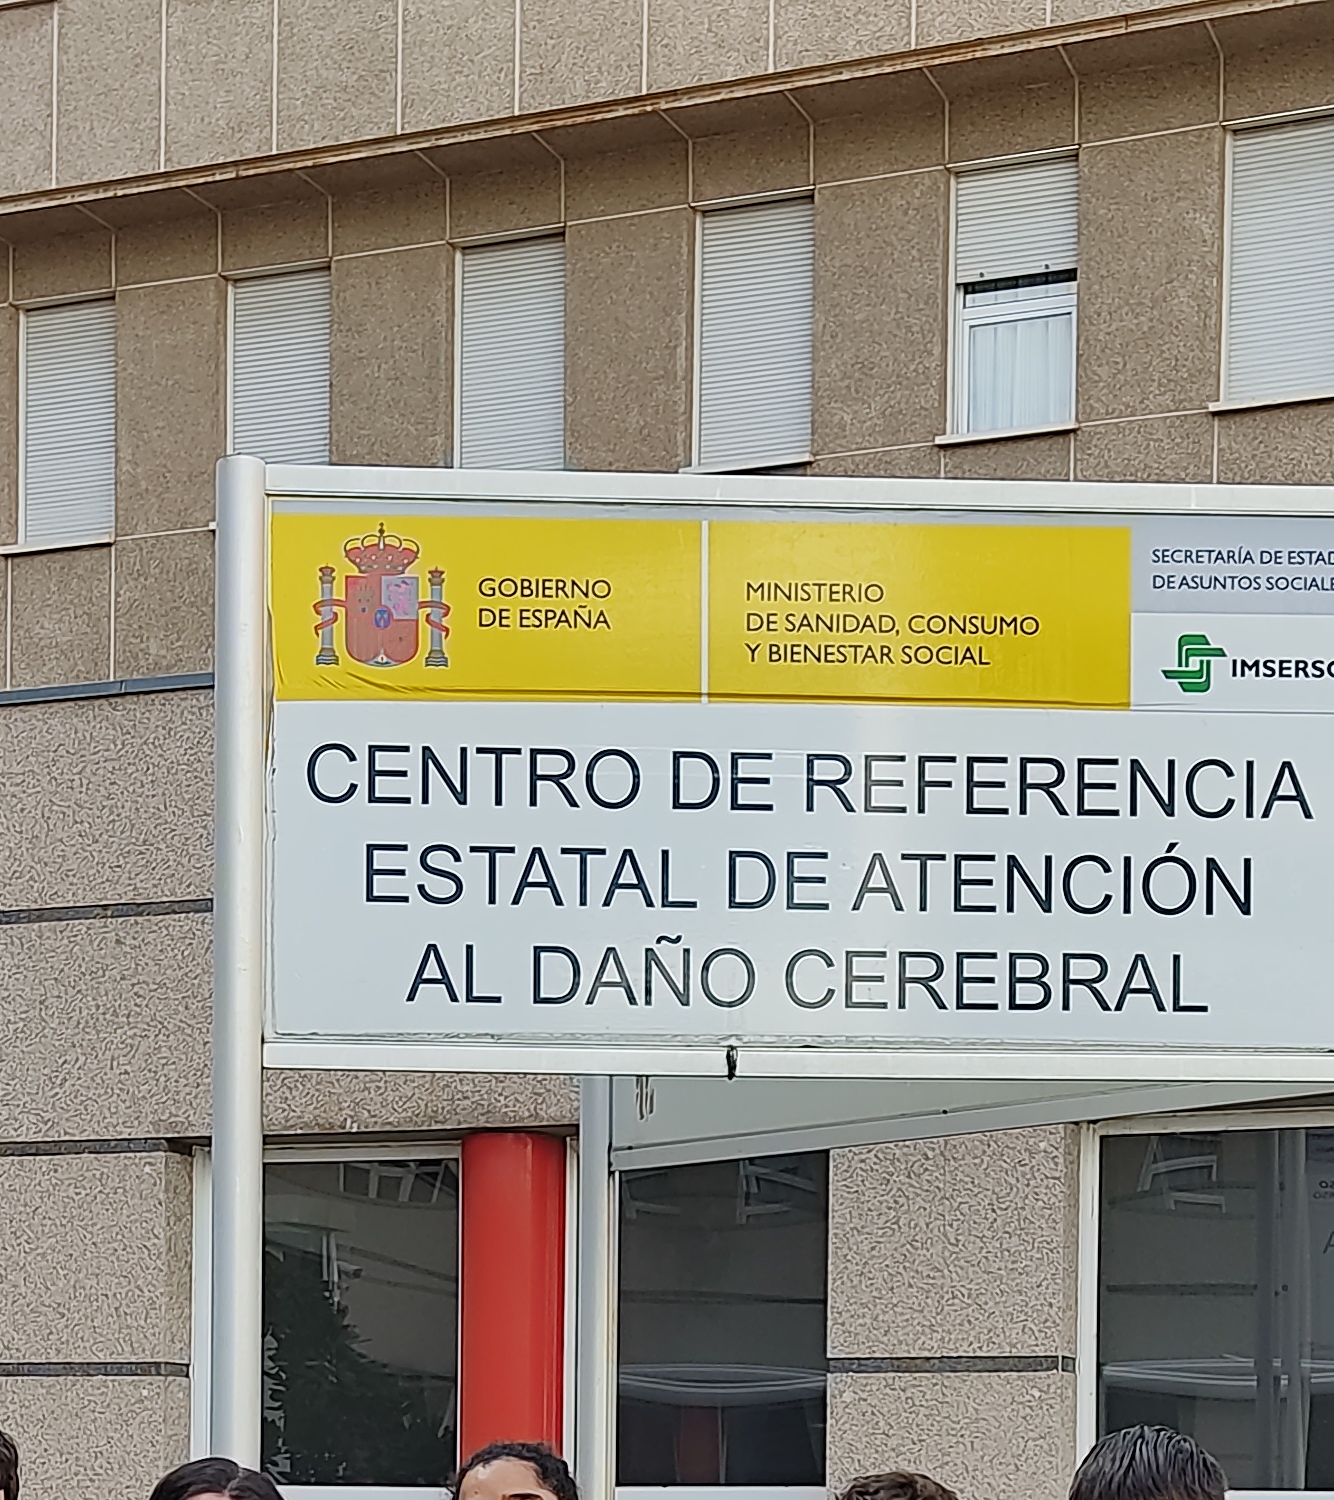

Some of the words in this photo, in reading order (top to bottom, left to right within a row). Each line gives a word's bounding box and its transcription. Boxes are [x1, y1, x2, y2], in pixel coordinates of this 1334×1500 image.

[1151, 545, 1256, 565] SECRETARÍA
[1259, 550, 1284, 566] DE
[478, 577, 612, 600] GOBIERNO
[746, 581, 885, 603] MINISTERIO
[1152, 574, 1177, 590] DE
[1178, 574, 1262, 591] ASUNTOS
[478, 607, 511, 629] DE
[519, 604, 612, 631] ESPAÑA
[746, 612, 778, 633] DE
[784, 613, 901, 637] SANIDAD,
[908, 614, 1041, 637] CONSUMO
[744, 643, 763, 664] Y
[768, 643, 895, 666] BIENESTAR
[900, 645, 992, 667] SOCIAL
[306, 742, 642, 811] CENTRO
[671, 750, 775, 812] DE
[805, 752, 1315, 821] REFERENCIA
[365, 842, 699, 910] ESTATAL
[727, 850, 830, 912] DE
[851, 840, 1253, 917] ATENCIÓN
[405, 943, 503, 1005] AL
[532, 934, 757, 1009] DAÑO
[785, 947, 1210, 1014] CEREBRAL
